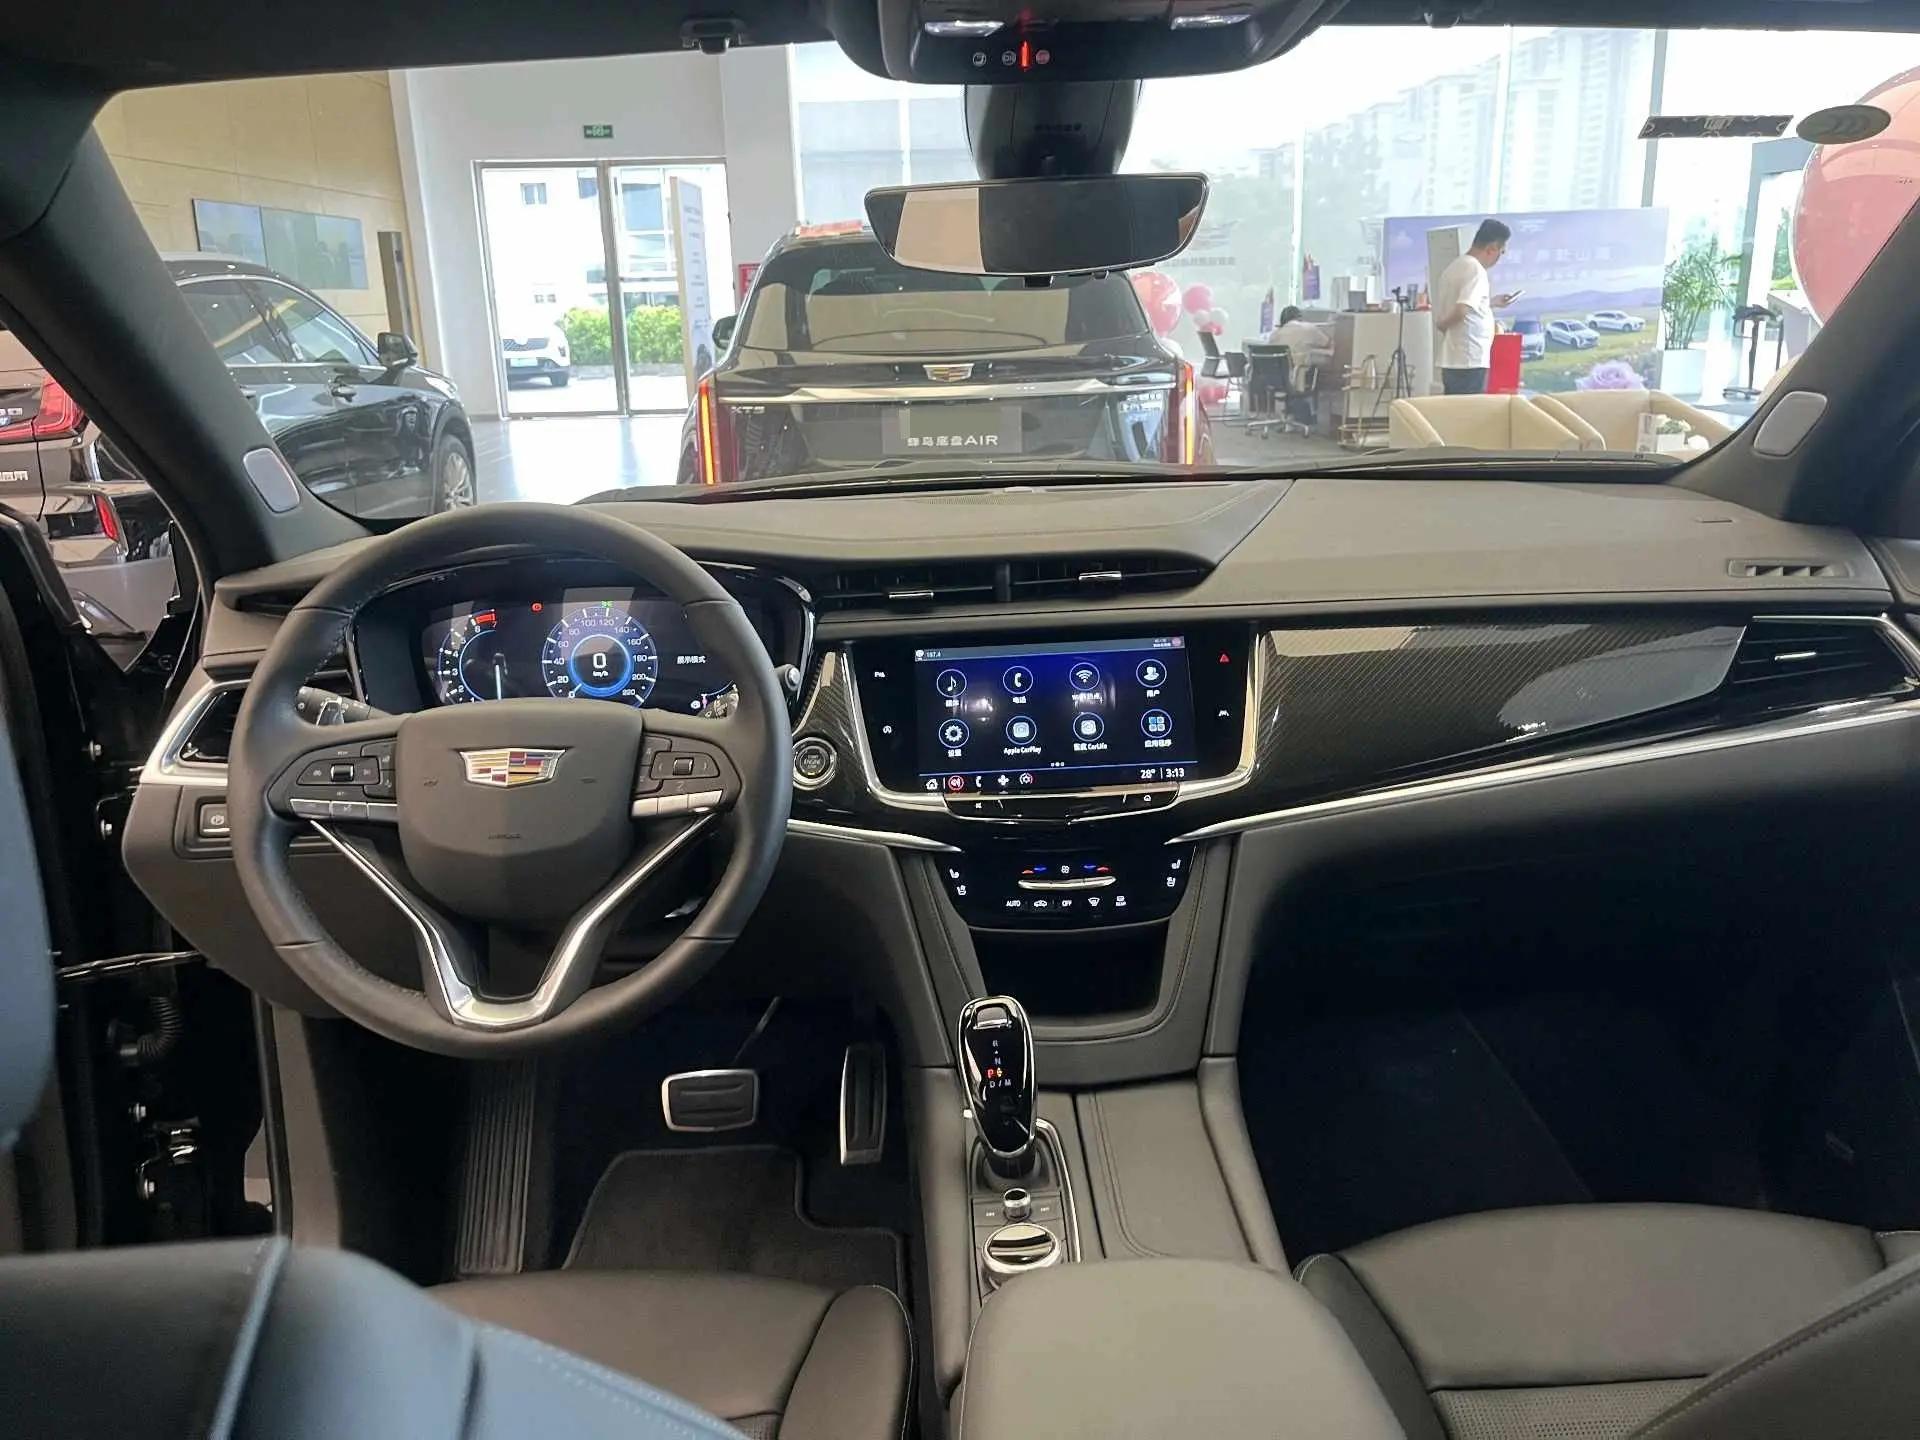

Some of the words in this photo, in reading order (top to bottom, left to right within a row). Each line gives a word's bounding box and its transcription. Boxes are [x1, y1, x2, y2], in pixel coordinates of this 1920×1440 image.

[581, 619, 597, 627] 100
[614, 626, 630, 634] 140
[553, 657, 565, 665] 40
[592, 652, 607, 669] 0
[451, 668, 459, 676] 3
[557, 675, 569, 684] 20
[1003, 746, 1020, 755] Apple
[1021, 745, 1042, 755] CarPlay
[1166, 767, 1185, 778] 3:13
[1061, 899, 1072, 907] OFF
[987, 1069, 994, 1079] P
